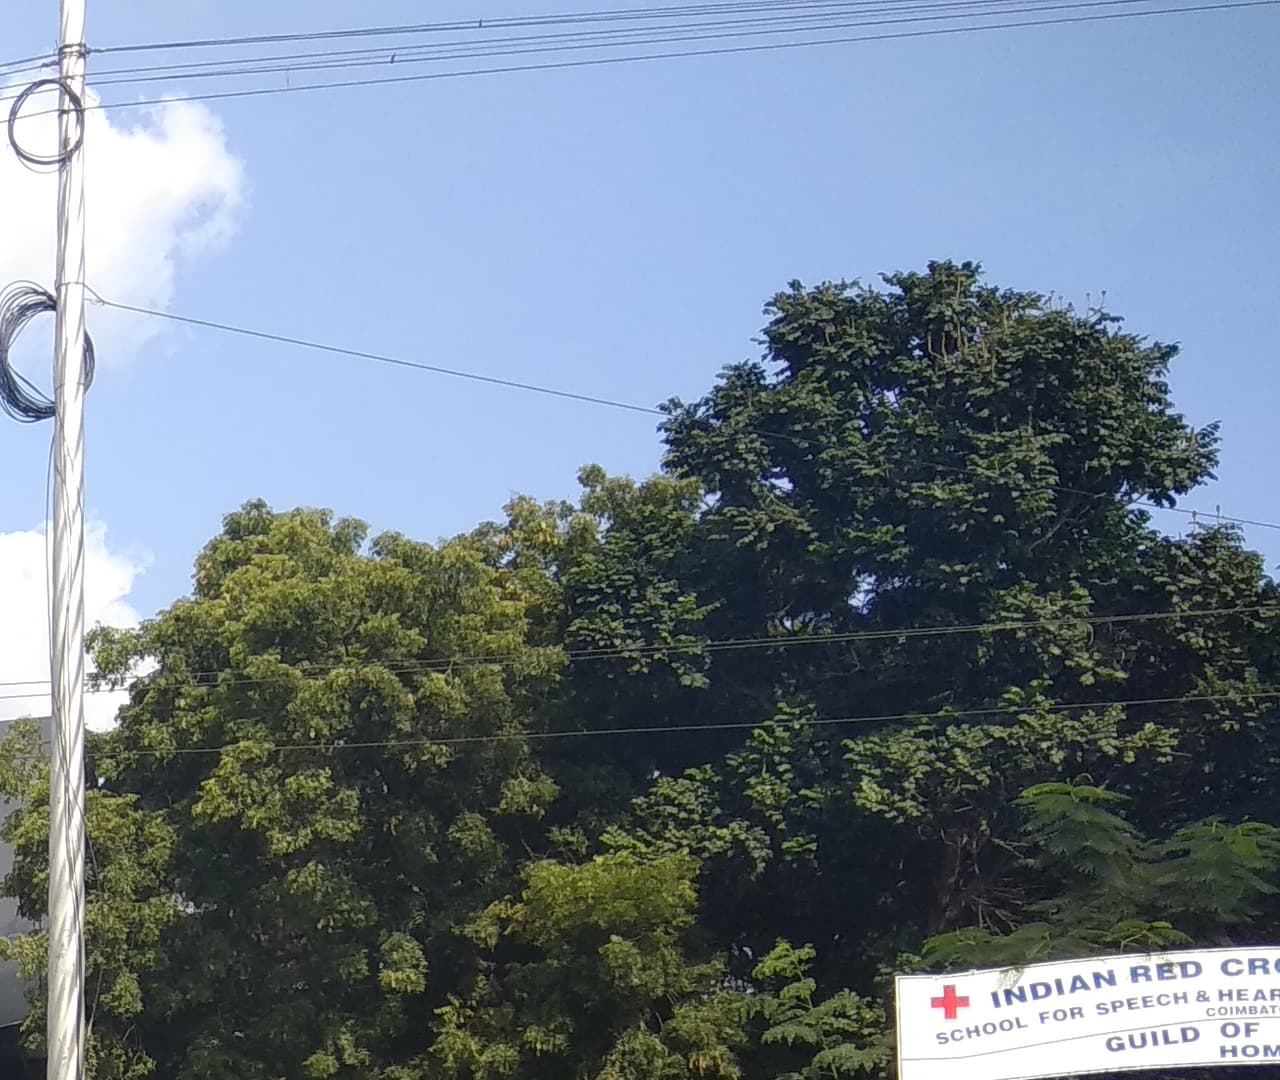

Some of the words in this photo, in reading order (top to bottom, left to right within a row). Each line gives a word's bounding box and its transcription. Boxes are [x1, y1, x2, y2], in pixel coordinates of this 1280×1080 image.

[990, 968, 1117, 1009] INDIAN
[1130, 959, 1203, 984] RED
[935, 1016, 1028, 1046] SCHOOL
[1039, 1005, 1085, 1025] FOR
[1096, 990, 1189, 1017] SPEECH
[1195, 990, 1211, 1003] &
[1205, 1004, 1280, 1018] COIMBAT
[1105, 1026, 1201, 1053] GUILD
[1220, 1021, 1260, 1039] OF
